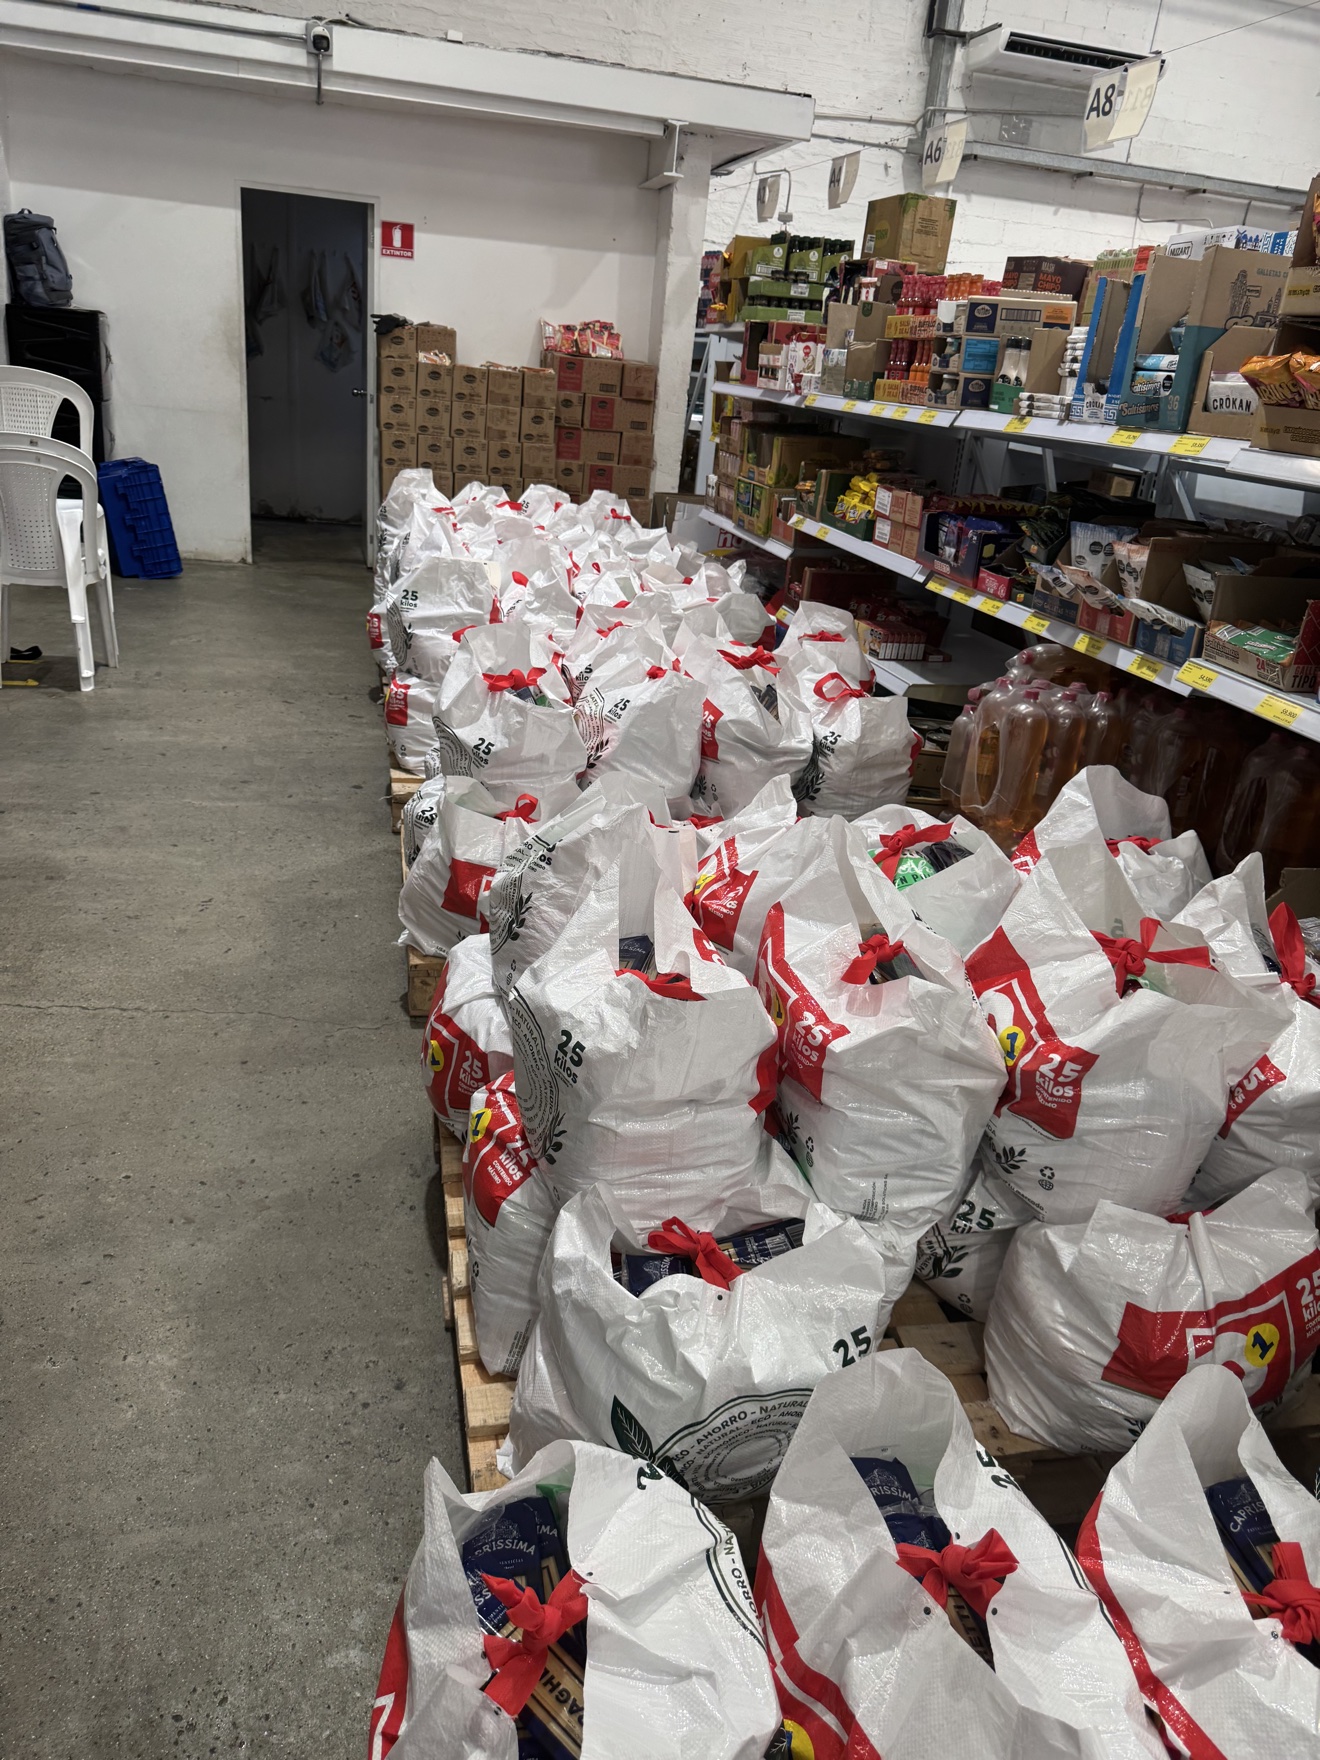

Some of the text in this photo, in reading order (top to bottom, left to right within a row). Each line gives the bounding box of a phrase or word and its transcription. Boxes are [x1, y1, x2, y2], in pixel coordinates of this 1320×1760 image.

[1086, 83, 1116, 120] A8
[924, 137, 943, 165] A6
[829, 166, 842, 189] A4
[382, 249, 413, 258] EXTINTOR
[1039, 272, 1062, 284] MAYO
[400, 599, 418, 608] kilos
[401, 589, 418, 602] 25
[1256, 657, 1266, 672] 24
[575, 674, 590, 682] kilo
[1291, 675, 1317, 689] TIPO
[607, 709, 623, 720] kilos
[613, 698, 631, 712] 25
[473, 737, 495, 756] 25
[822, 731, 842, 745] 25
[795, 1011, 832, 1047] 25
[557, 1029, 587, 1068] 25
[1006, 1032, 1019, 1061] 1
[462, 1050, 484, 1079] 25
[554, 1050, 578, 1084] kilos
[1038, 1053, 1083, 1083] 25
[1035, 1070, 1074, 1097] kilos
[1035, 1085, 1072, 1103] CONTENIDO
[1035, 1090, 1057, 1109] MÁXIMO
[472, 1111, 486, 1137] 1
[487, 1165, 502, 1184] MÁXIMO
[493, 1160, 513, 1186] CONTENIDO
[499, 1150, 524, 1181] kilos
[950, 1220, 972, 1234] kil
[956, 1199, 996, 1231] 25
[832, 1325, 872, 1367] 25
[1251, 1330, 1275, 1361] 1
[696, 1411, 748, 1445] AHORRO
[759, 1400, 809, 1415] NATURAL
[697, 1426, 743, 1455] NATURAL
[751, 1414, 771, 1425] ECO
[1229, 1501, 1266, 1533] CAPRIS
